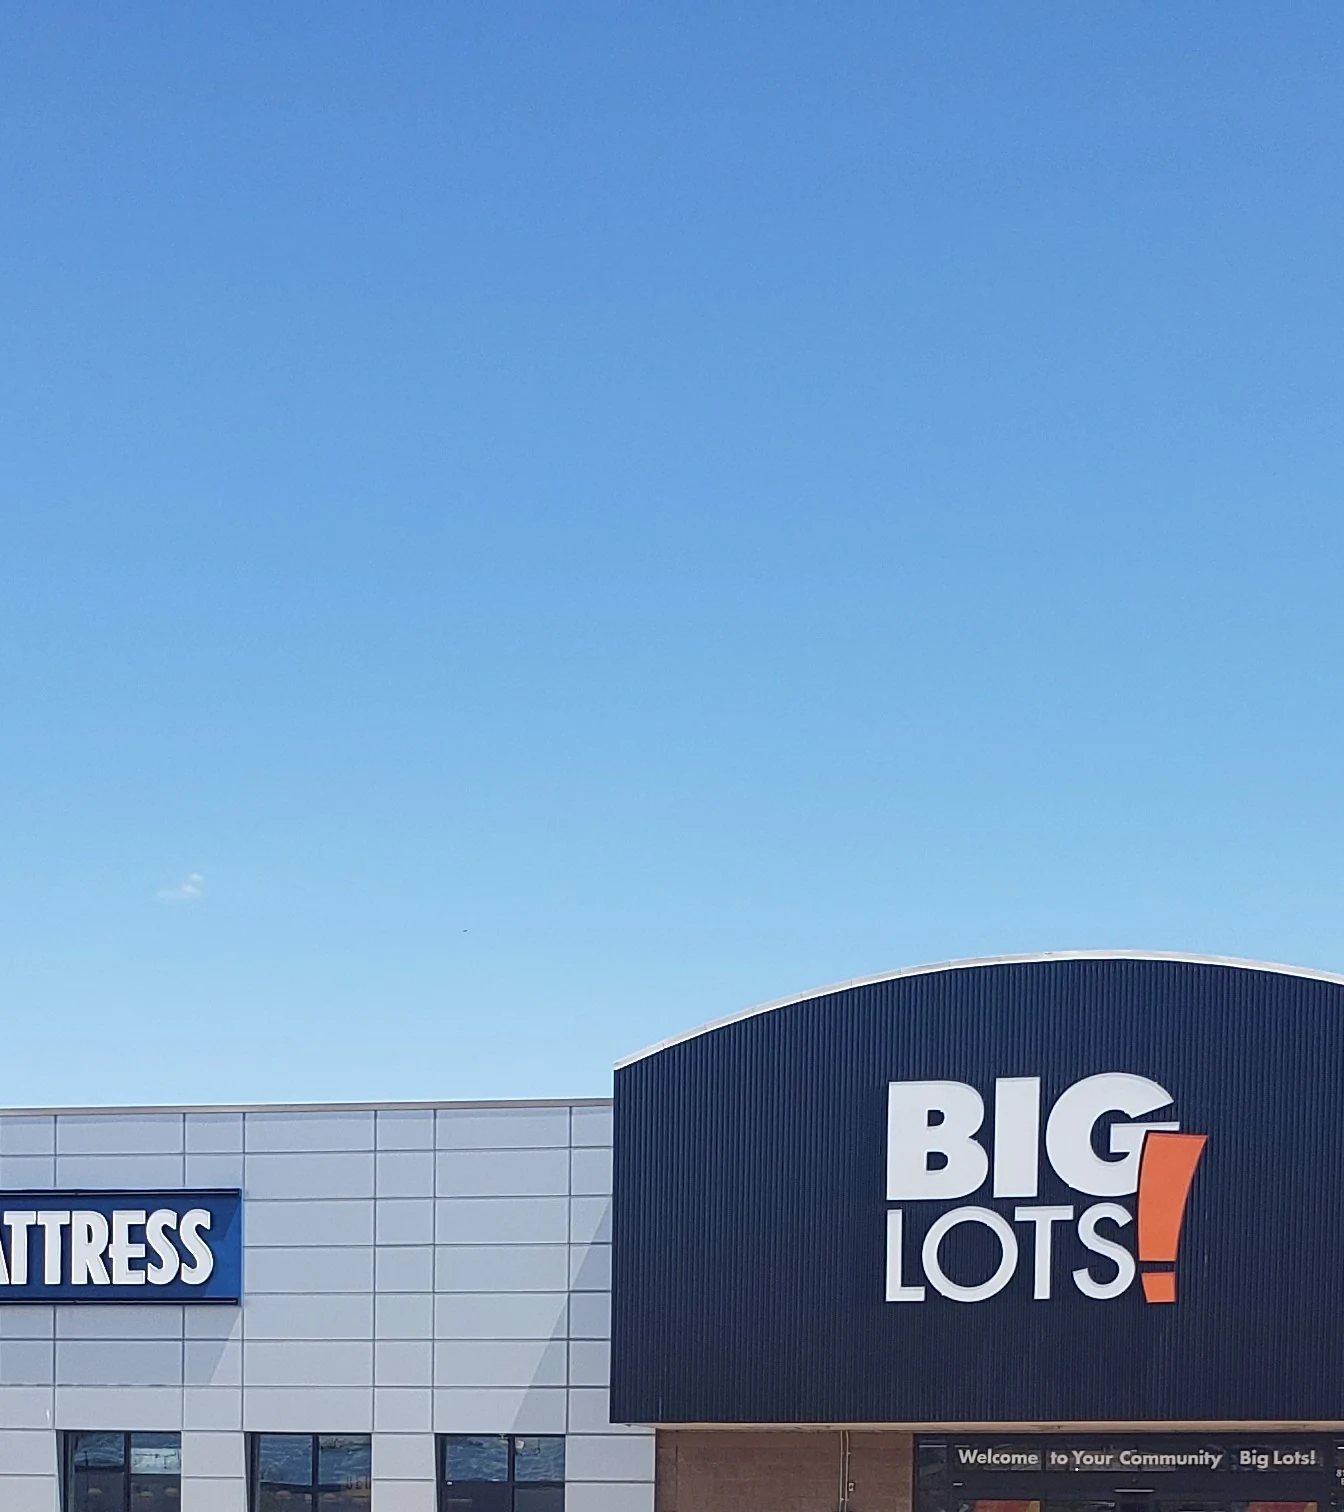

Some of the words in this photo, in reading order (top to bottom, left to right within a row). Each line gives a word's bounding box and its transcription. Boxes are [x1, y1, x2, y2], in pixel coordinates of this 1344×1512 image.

[886, 1072, 1180, 1200] BIG
[958, 1449, 1038, 1465] Welcome
[1051, 1451, 1068, 1465] to
[1072, 1450, 1114, 1465] Your
[1120, 1450, 1222, 1469] Community
[1240, 1450, 1269, 1468] Big
[1273, 1450, 1316, 1465] Lots!
